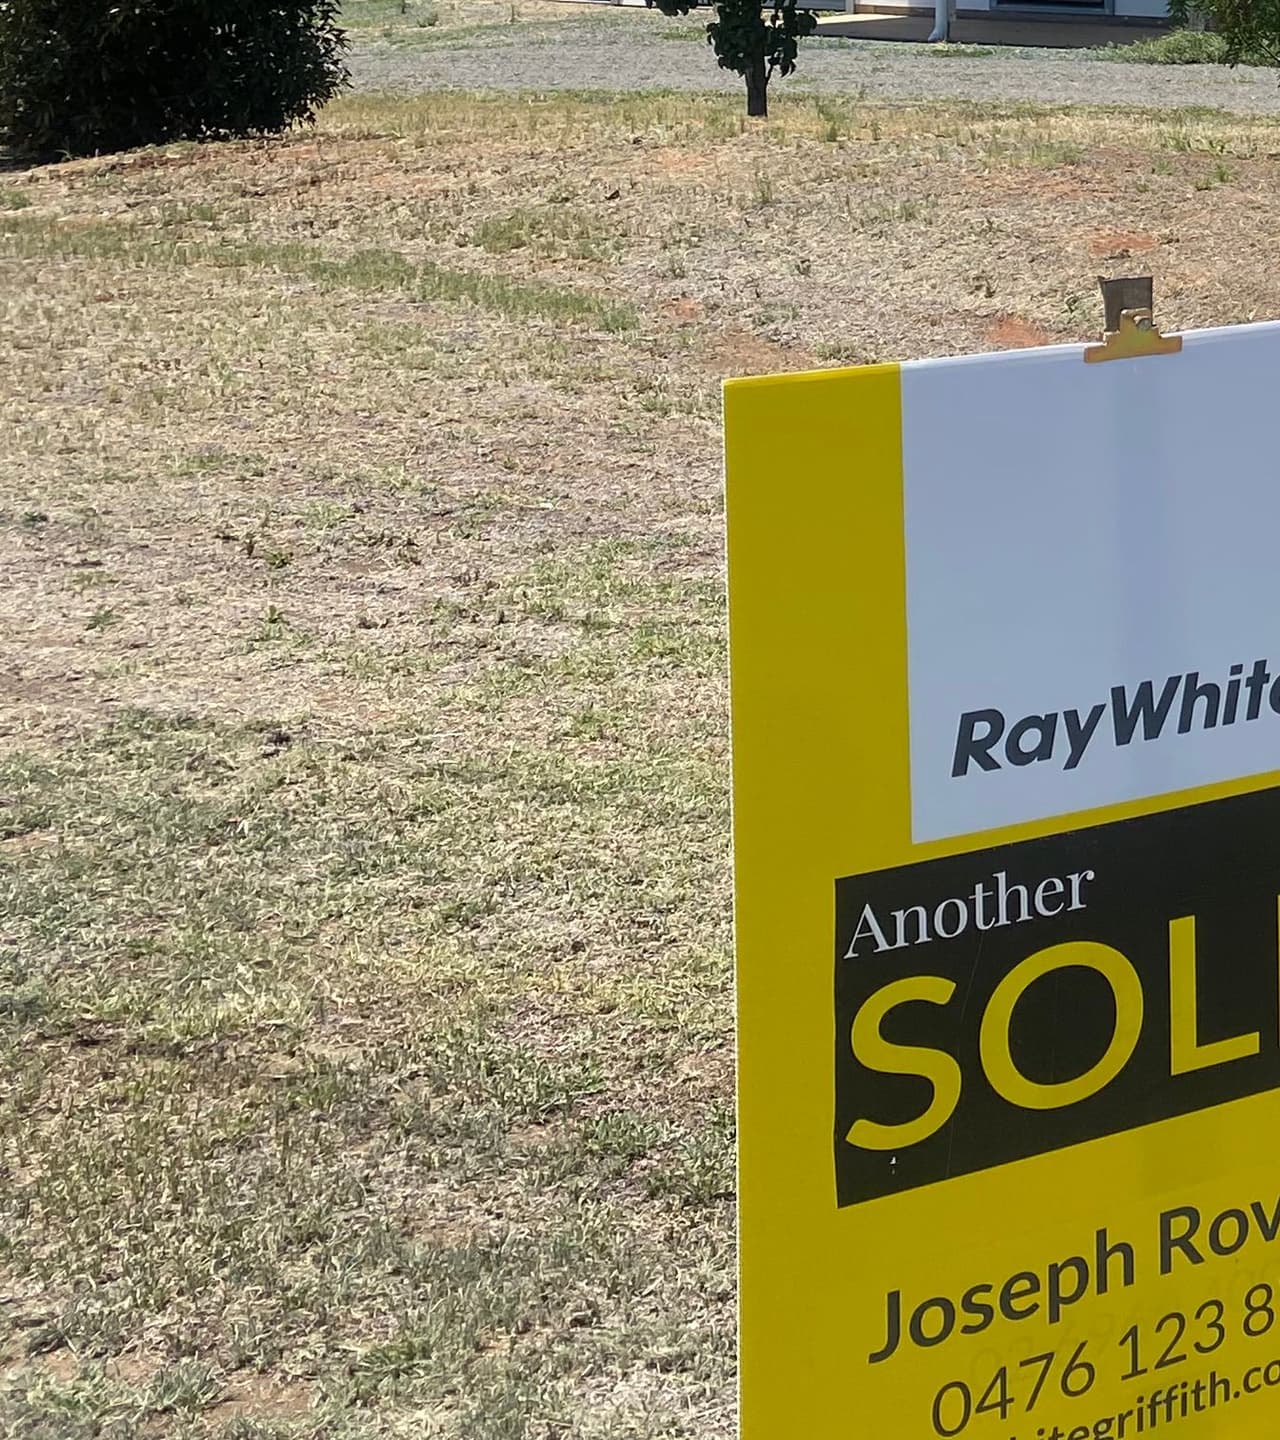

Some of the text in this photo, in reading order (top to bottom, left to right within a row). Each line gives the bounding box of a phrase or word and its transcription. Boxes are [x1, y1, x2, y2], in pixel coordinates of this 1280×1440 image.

[844, 870, 1095, 960] Another
[868, 1227, 1135, 1364] Joseph
[932, 1340, 1096, 1438] 0476
[1118, 1299, 1226, 1382] 123
